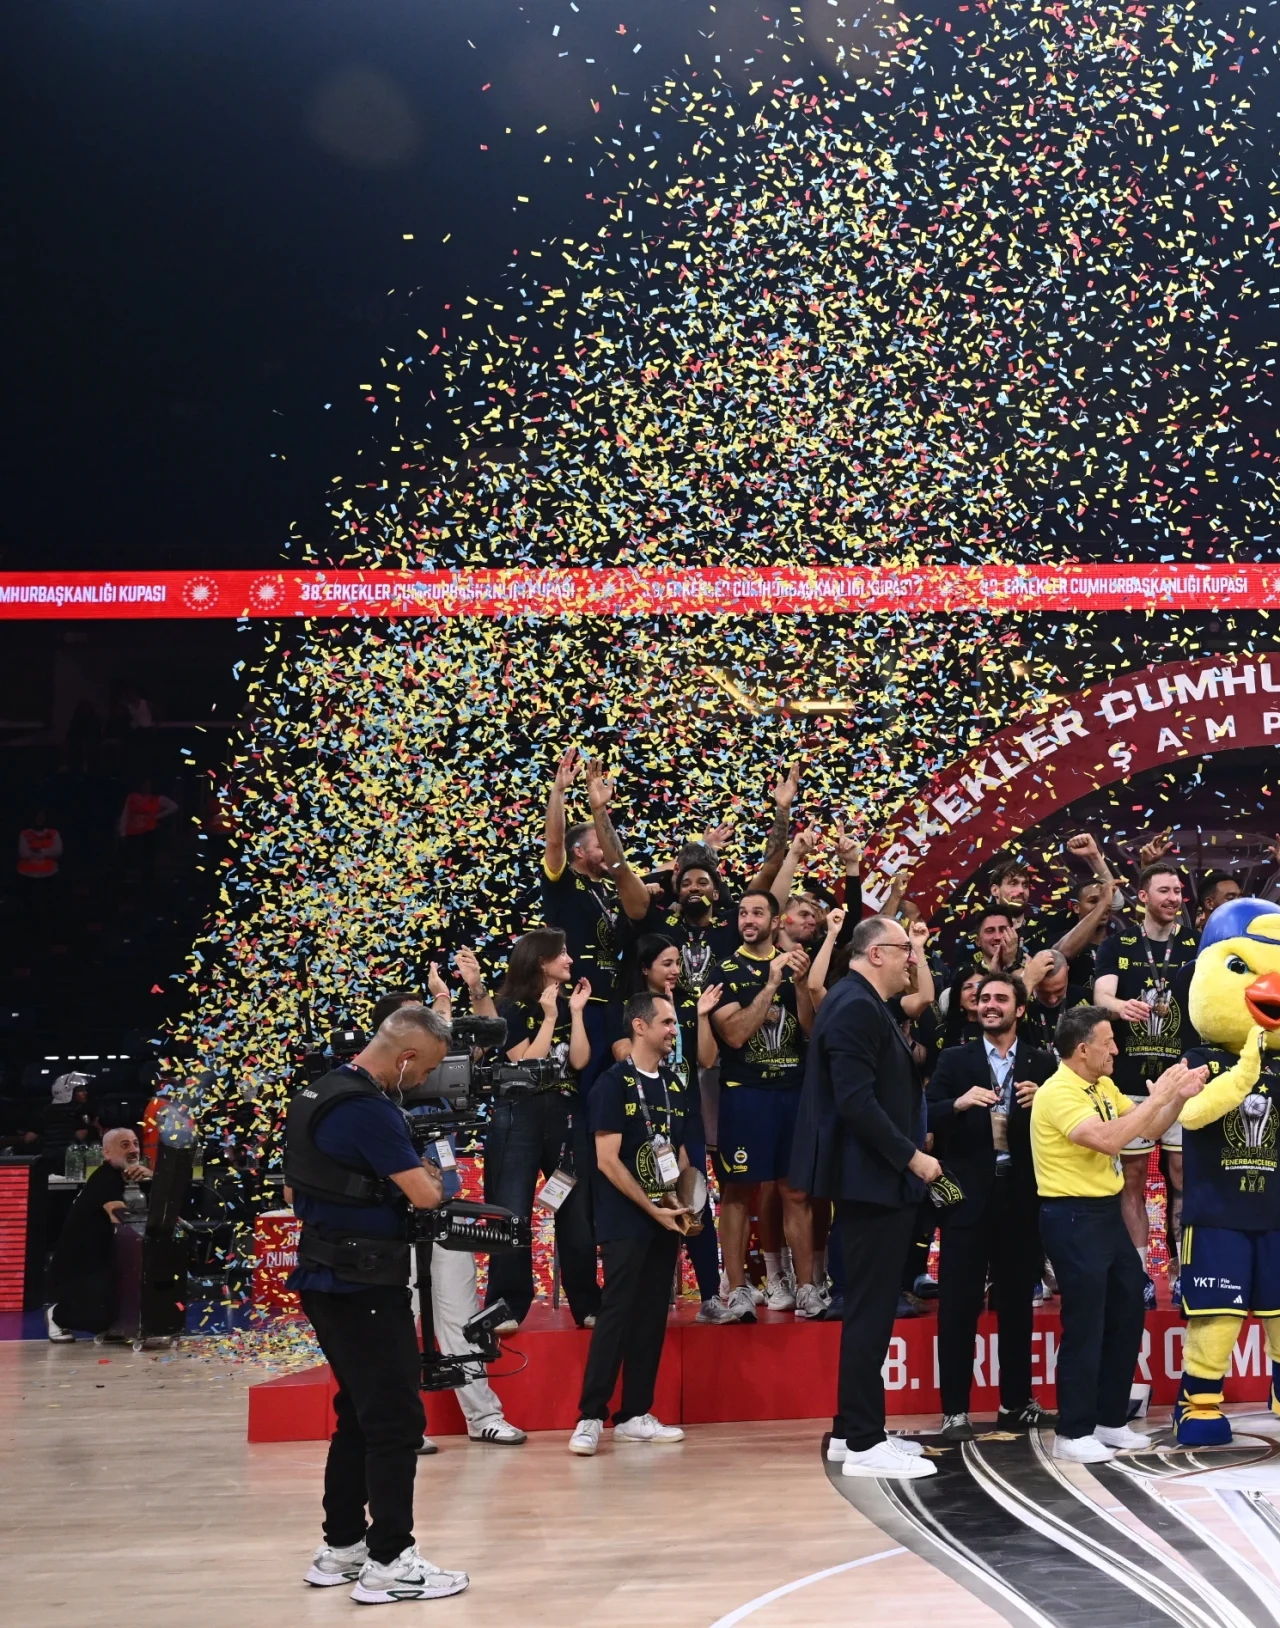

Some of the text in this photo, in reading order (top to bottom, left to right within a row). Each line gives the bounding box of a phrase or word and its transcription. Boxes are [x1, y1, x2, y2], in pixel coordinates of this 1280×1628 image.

[119, 585, 166, 601] KUPASI
[301, 584, 322, 600] 38.
[326, 583, 390, 600] ERKEKLER
[1202, 577, 1248, 593] KUPASI
[861, 709, 1090, 913] ERKEKLER
[1193, 1276, 1216, 1288] YKT
[881, 1336, 920, 1391] 8.
